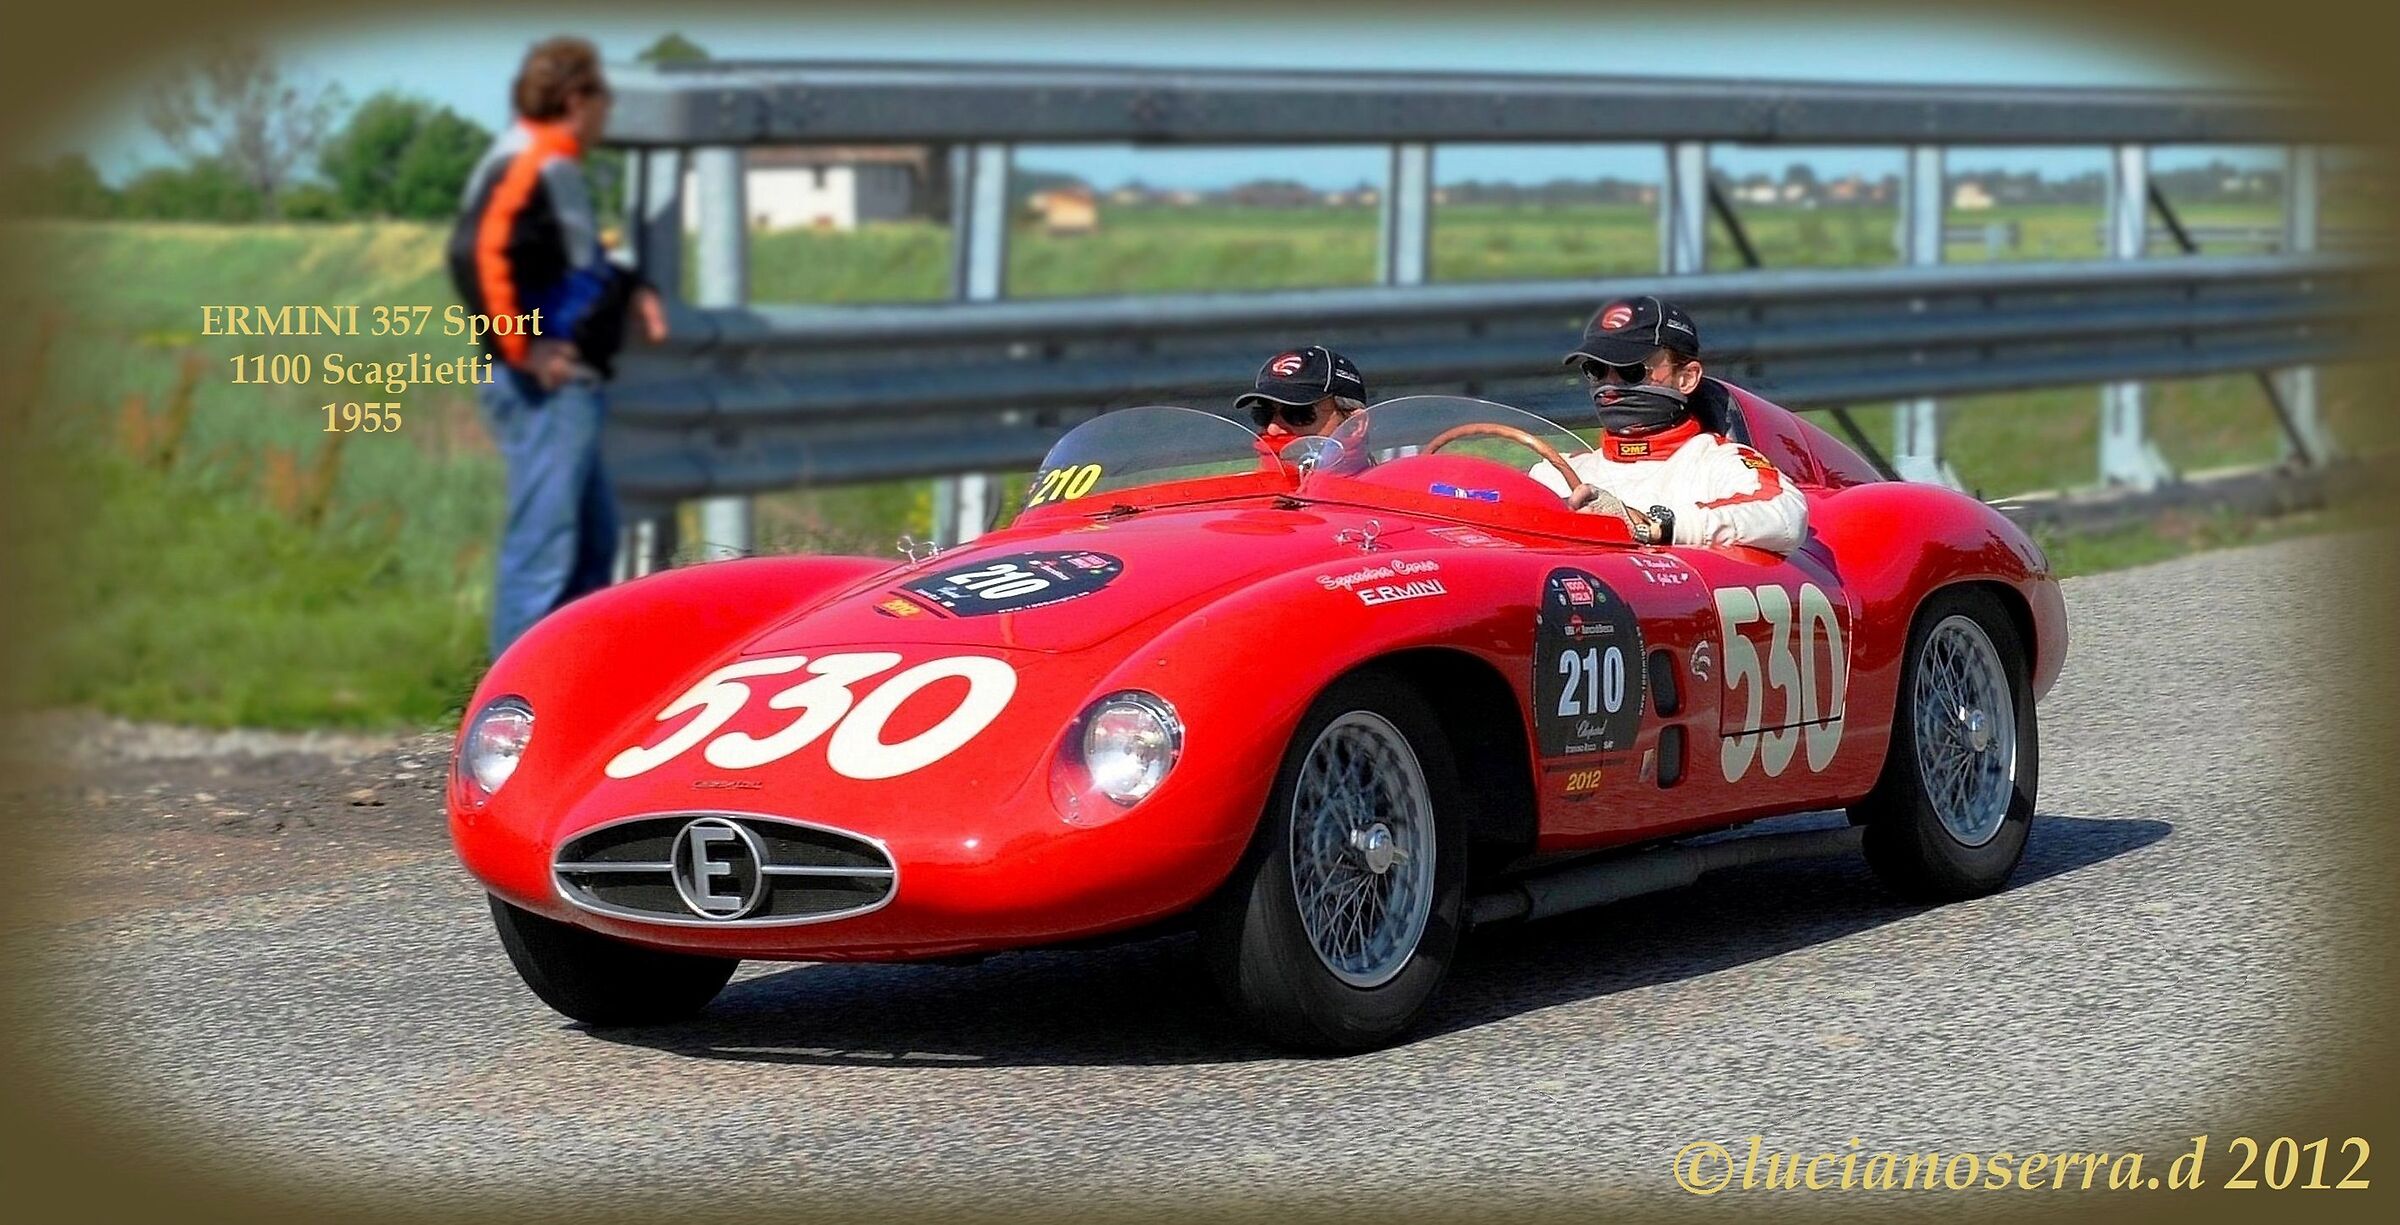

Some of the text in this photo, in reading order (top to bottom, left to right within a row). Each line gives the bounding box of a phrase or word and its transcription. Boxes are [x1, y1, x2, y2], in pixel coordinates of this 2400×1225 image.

[1028, 464, 1102, 508] 210
[945, 563, 1050, 600] 210
[1357, 579, 1446, 606] ERMINI
[1558, 646, 1625, 717] 210
[1714, 582, 1845, 784] 530
[605, 652, 1018, 780] 530
[1566, 769, 1602, 791] 2012
[689, 826, 743, 912] E
